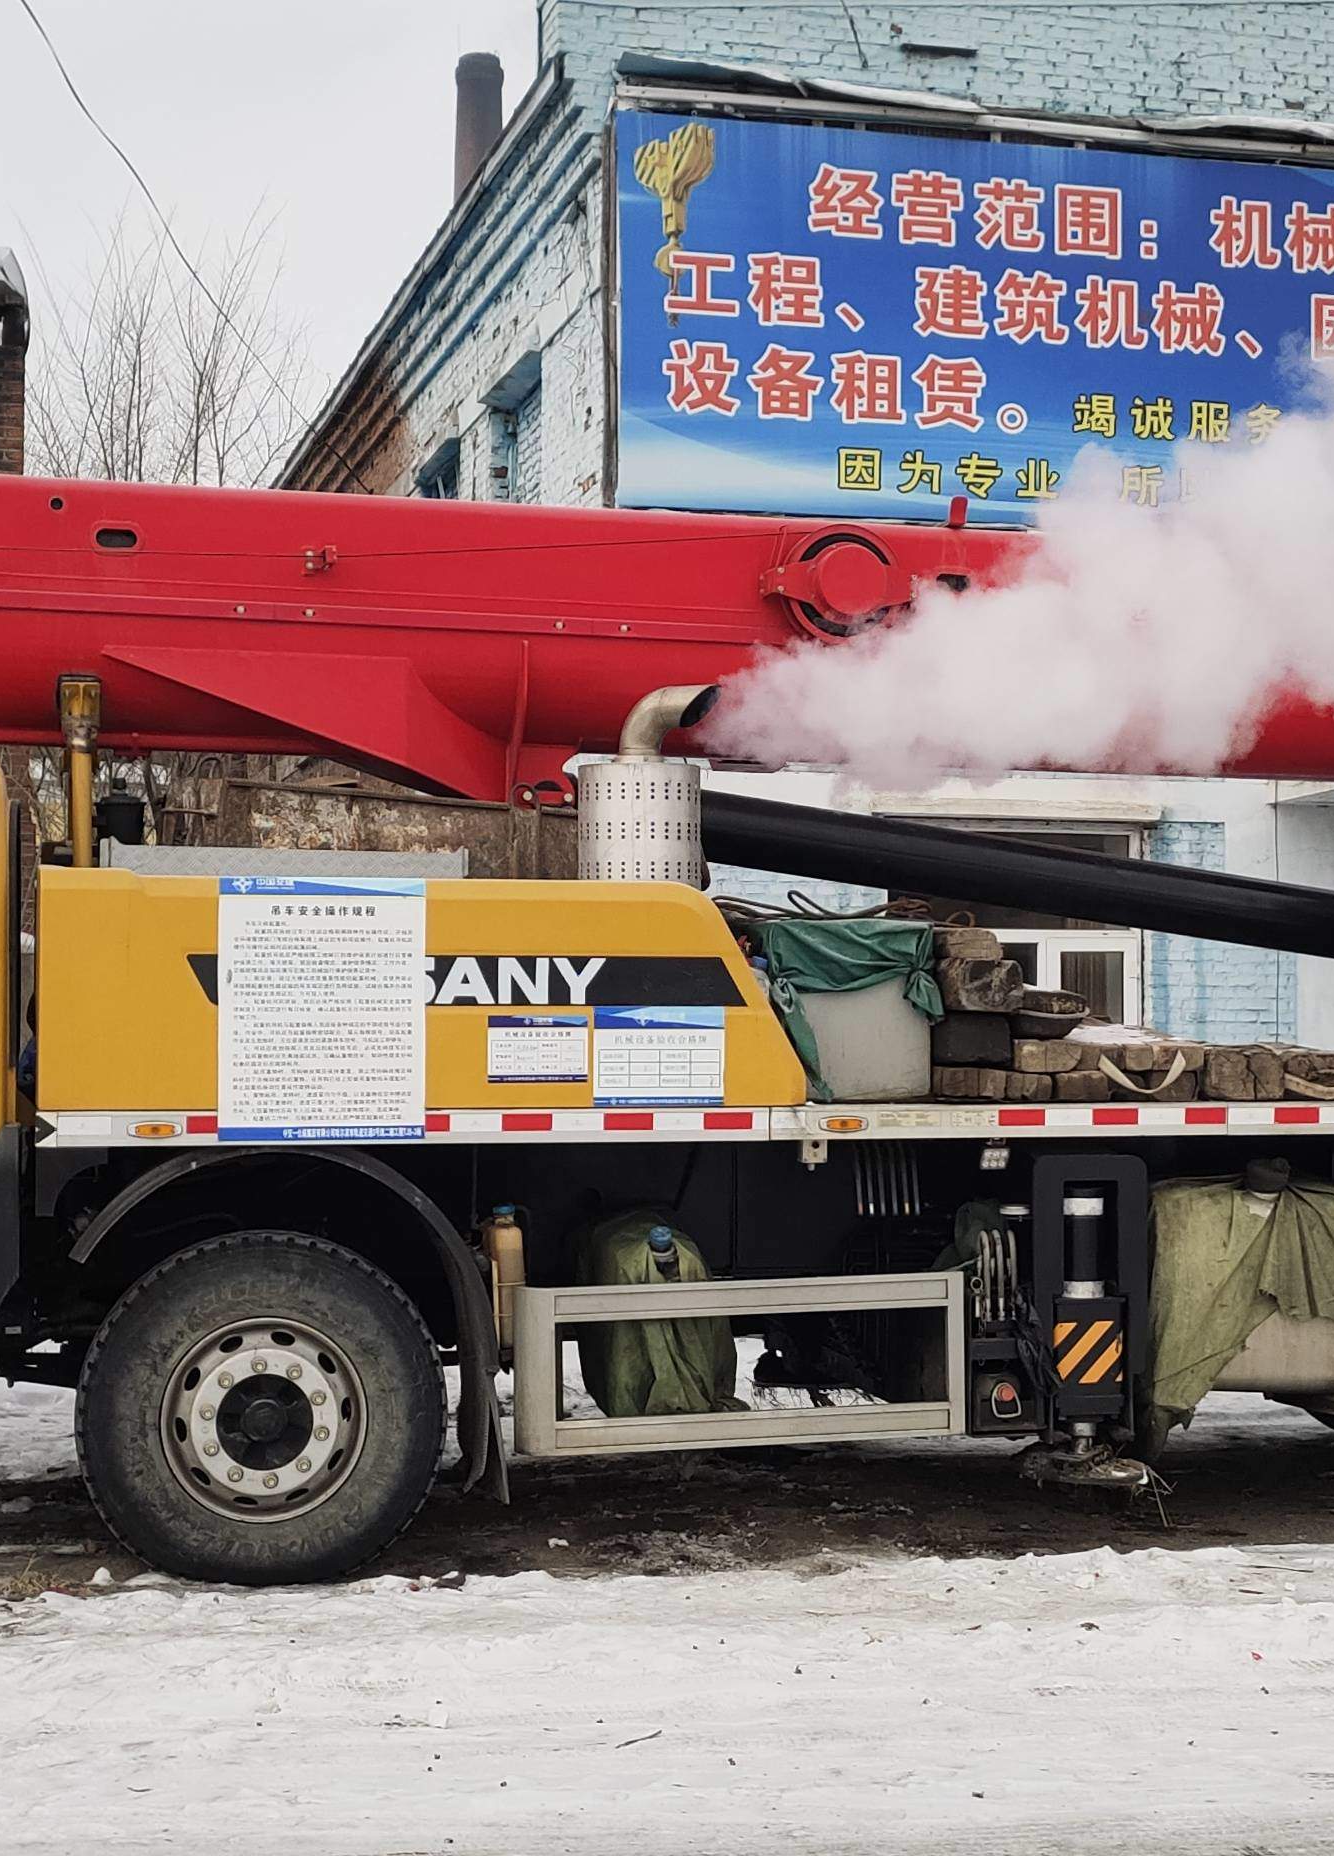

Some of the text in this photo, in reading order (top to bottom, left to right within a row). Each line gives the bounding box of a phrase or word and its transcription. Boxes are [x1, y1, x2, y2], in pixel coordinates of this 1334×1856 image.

[1073, 393, 1283, 446] 竭诚服务
[271, 905, 376, 917] 吊车安全操作规程
[425, 957, 606, 1005] ANY
